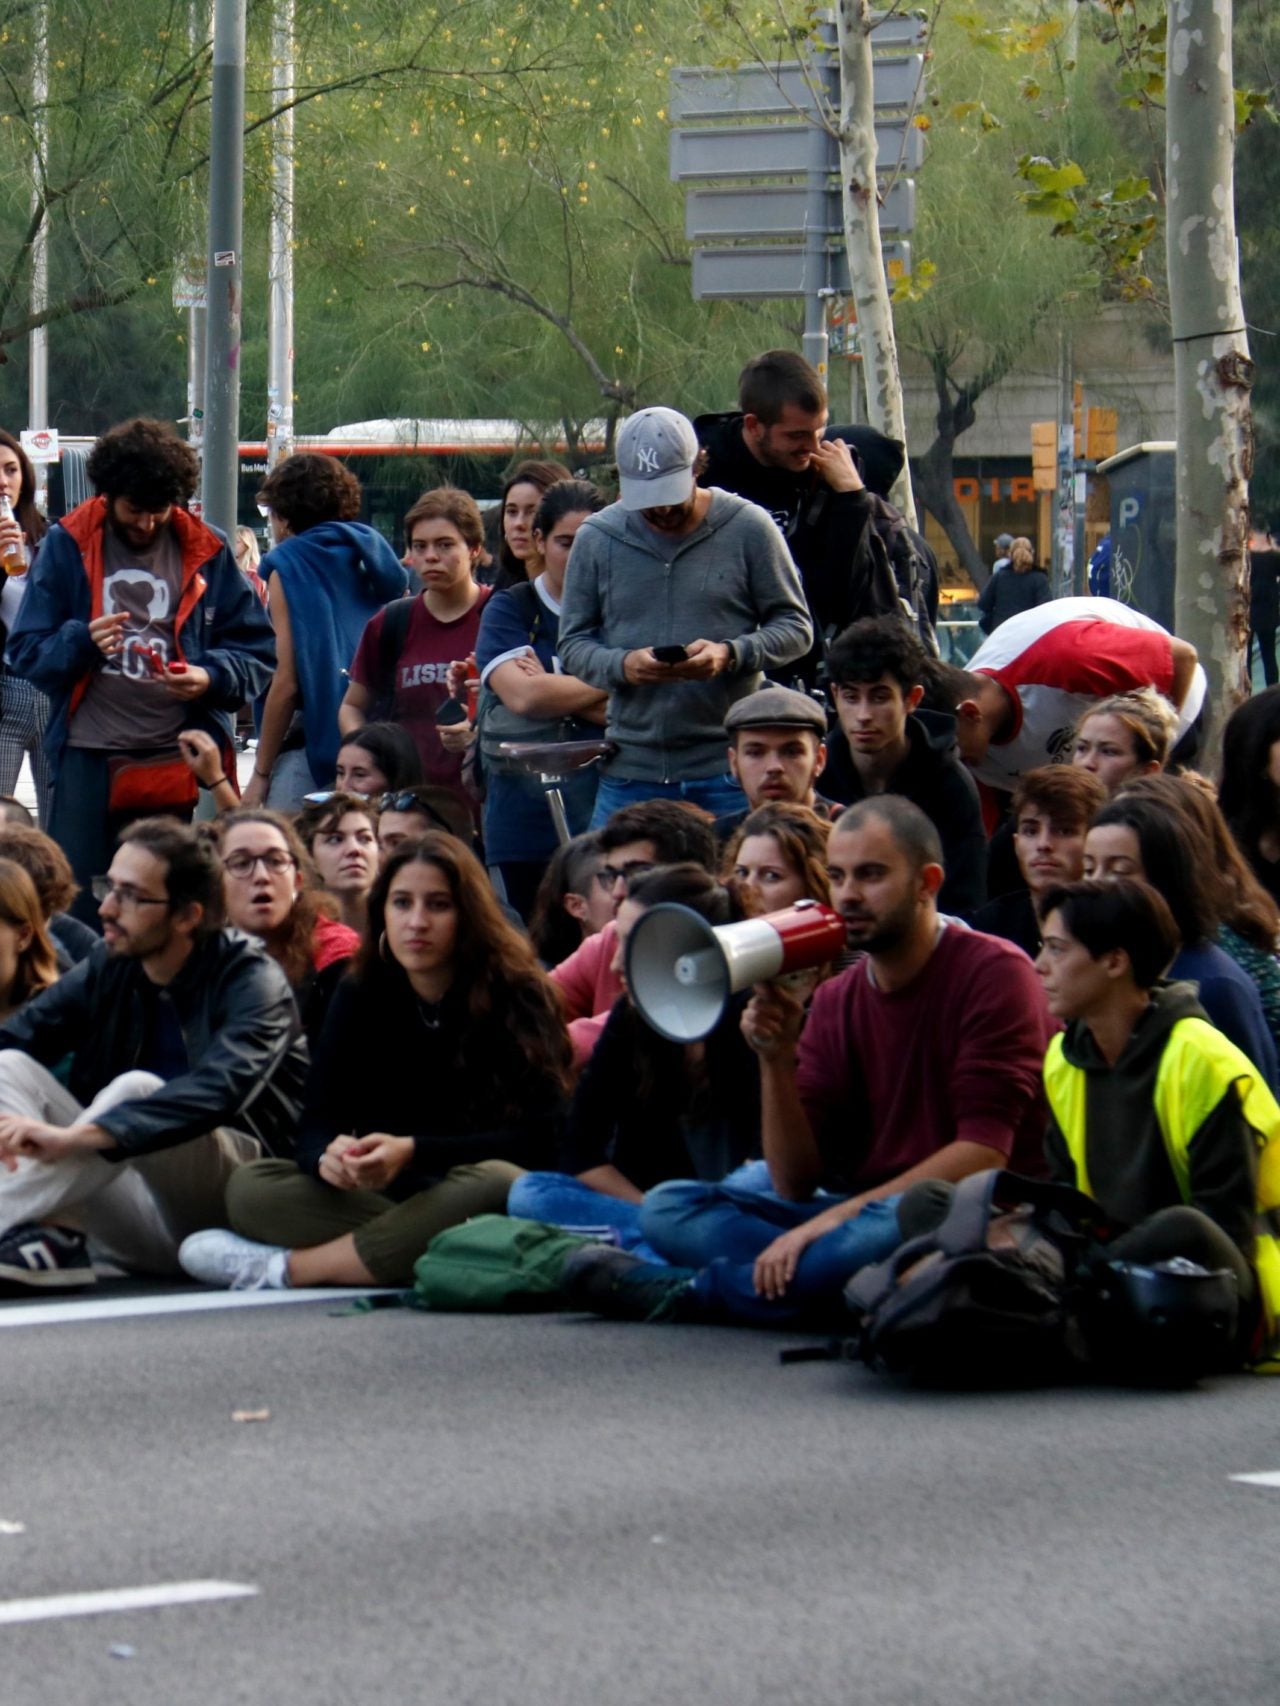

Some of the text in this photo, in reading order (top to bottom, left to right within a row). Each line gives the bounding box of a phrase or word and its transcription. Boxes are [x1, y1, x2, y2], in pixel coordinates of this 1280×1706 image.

[241, 463, 253, 473] Bus
[637, 447, 660, 472] NY
[1120, 497, 1140, 528] P
